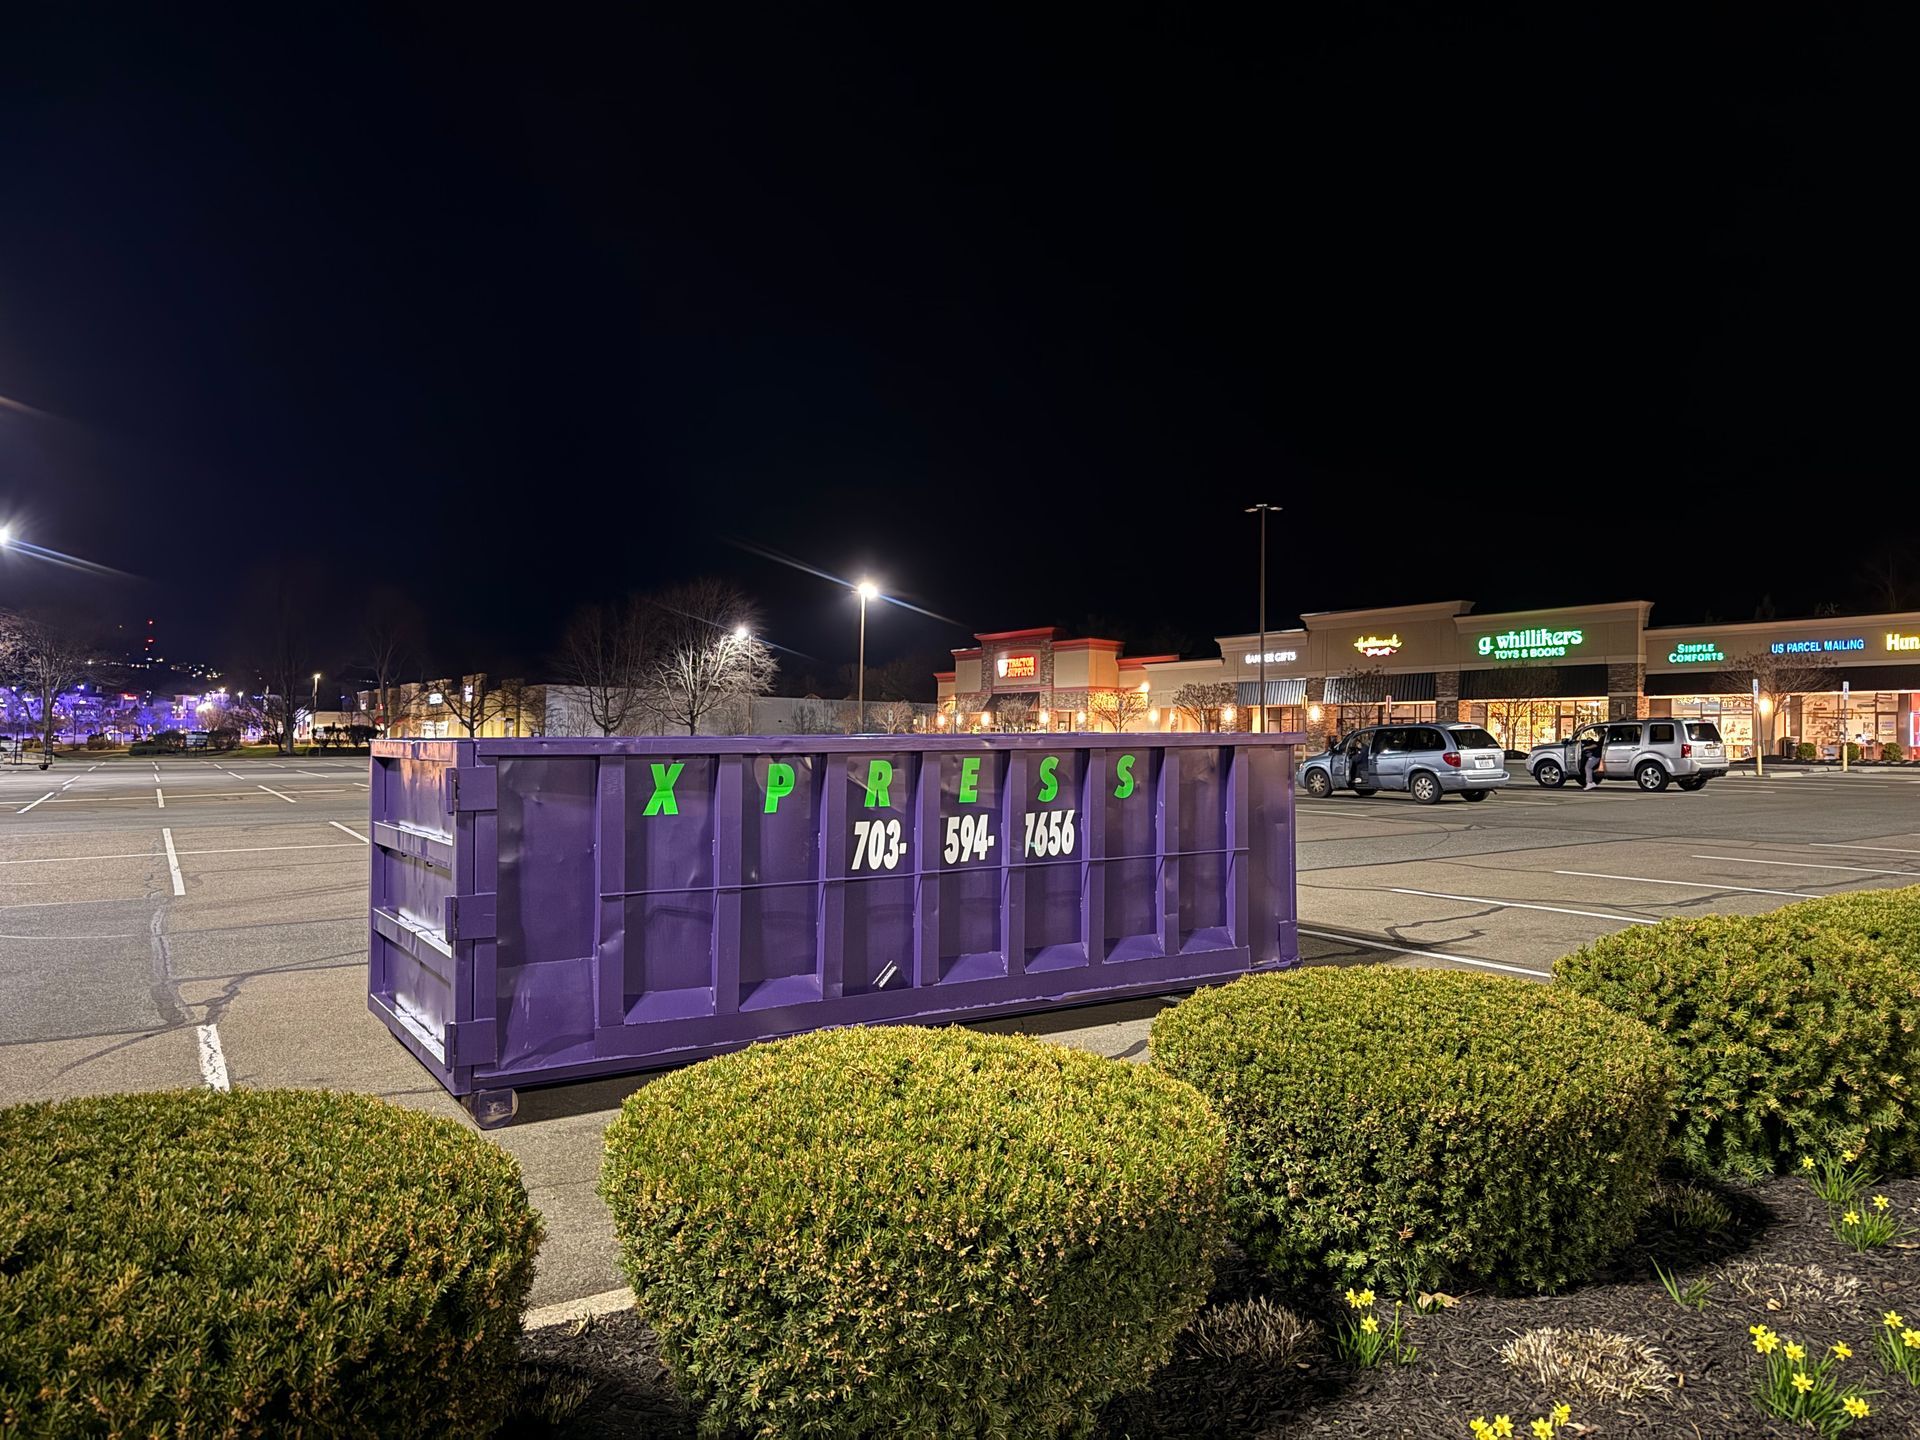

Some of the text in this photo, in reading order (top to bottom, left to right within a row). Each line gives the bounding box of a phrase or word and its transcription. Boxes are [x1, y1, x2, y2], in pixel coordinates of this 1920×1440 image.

[1496, 629, 1583, 649] whillikers
[1771, 639, 1864, 653] US PARCEL MAILING
[1886, 633, 1920, 650] Hun
[1495, 646, 1565, 660] TOYS & BOOKS
[1677, 643, 1714, 653] SIMPLE
[1275, 651, 1296, 662] GIFTS
[1668, 652, 1724, 663] COMFORTS
[851, 809, 1076, 870] 703- 594- 7656
